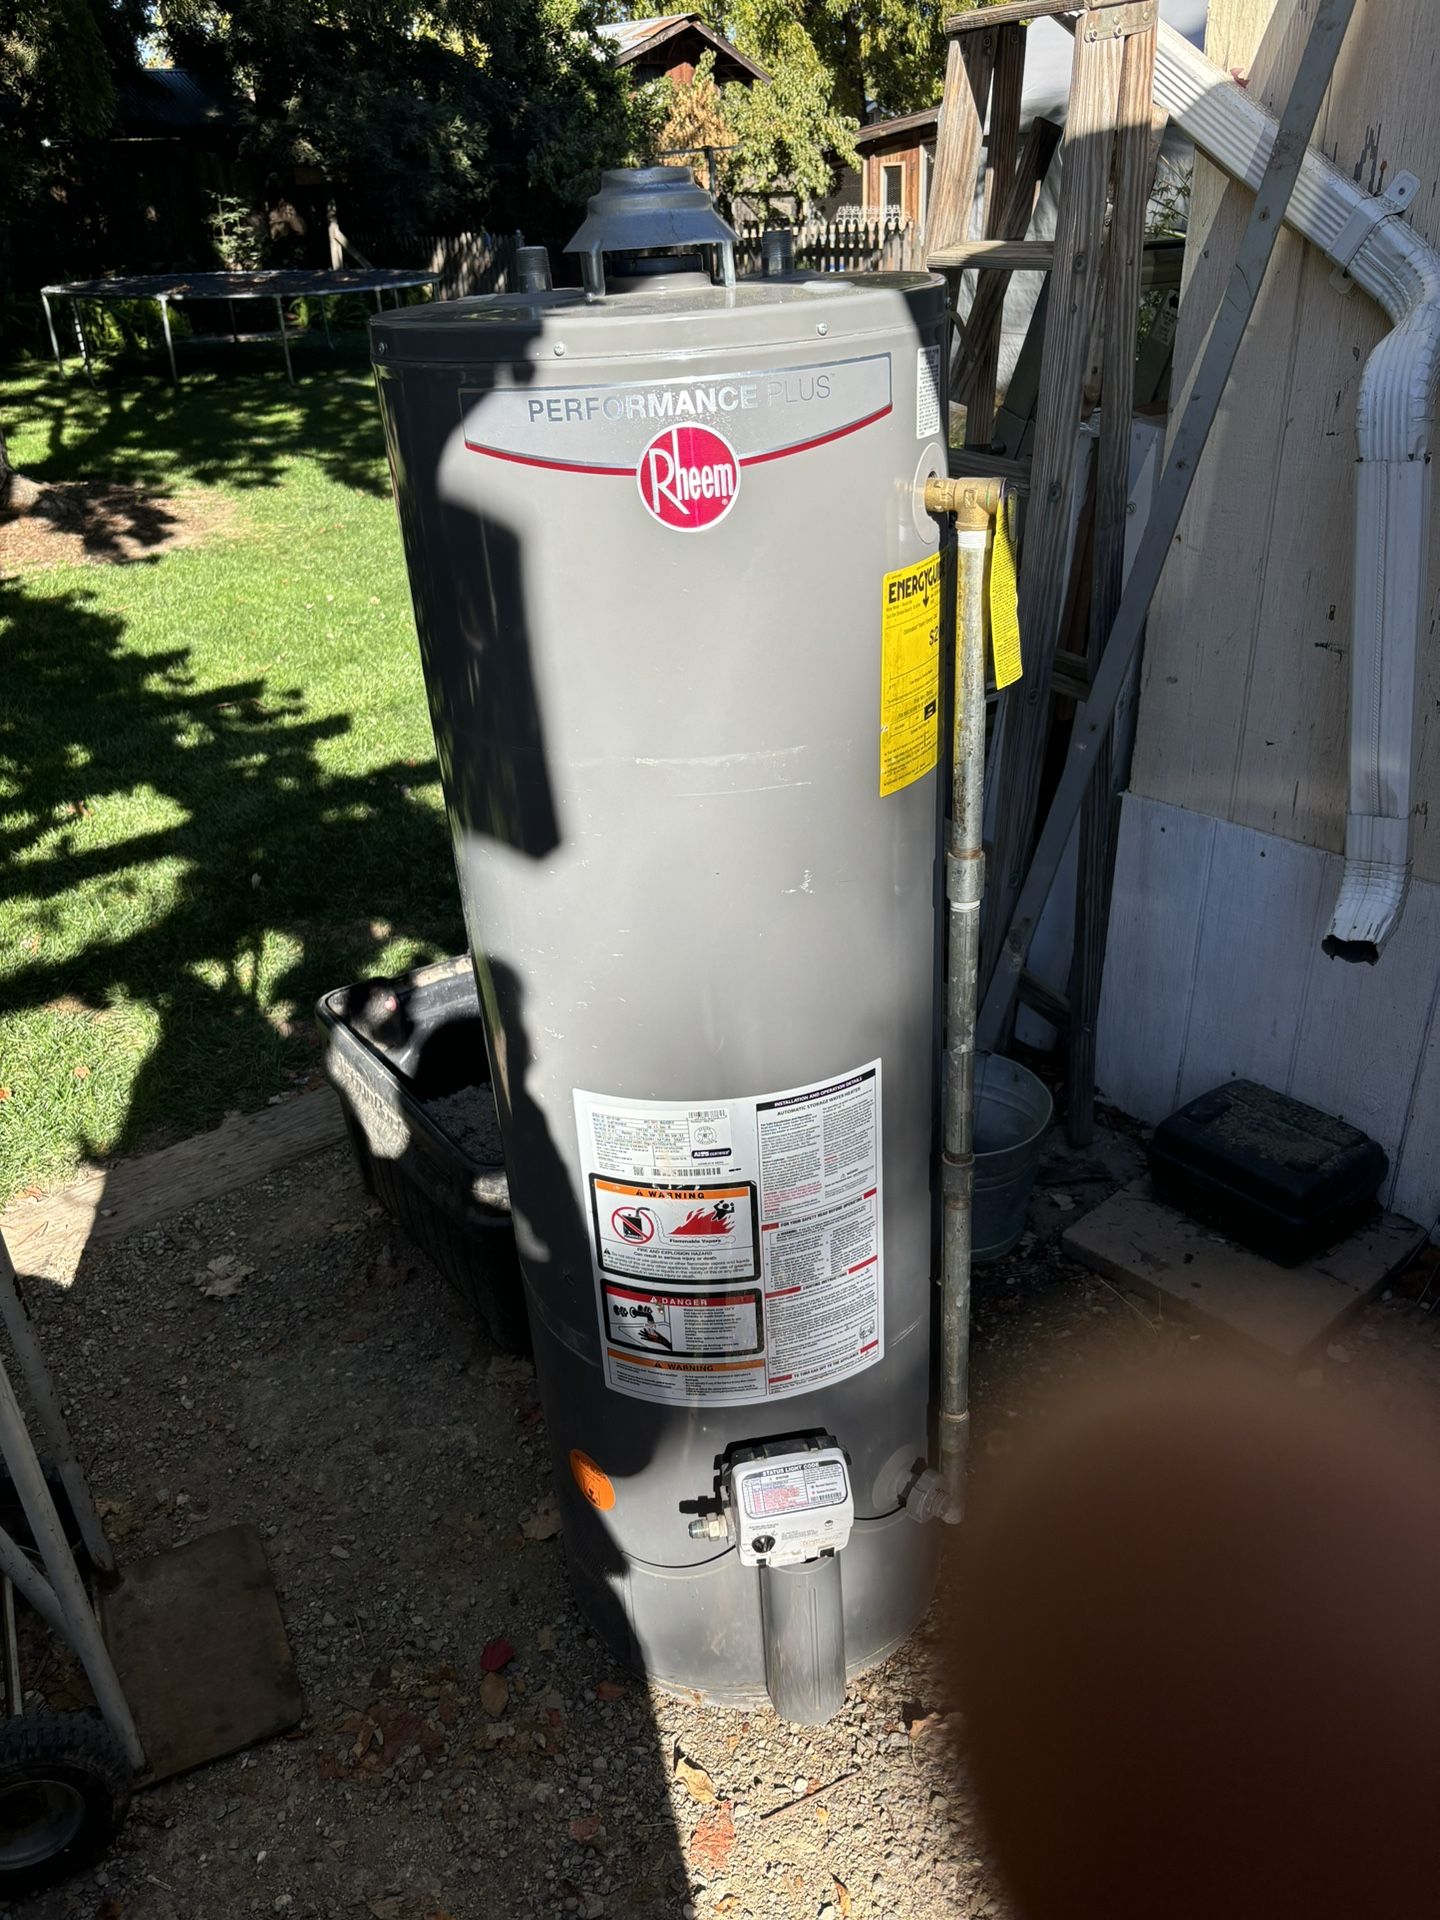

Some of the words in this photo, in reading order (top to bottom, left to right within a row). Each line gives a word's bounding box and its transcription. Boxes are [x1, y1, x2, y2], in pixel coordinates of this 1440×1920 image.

[528, 384, 757, 422] PERFORMANCE
[649, 428, 734, 515] Rheem
[774, 1095, 809, 1107] INSTALLATION
[820, 1084, 846, 1096] OPERATION
[846, 1076, 863, 1087] DETAILS
[777, 1106, 806, 1116] AUTOMATIC
[807, 1099, 828, 1109] STORAGE
[648, 1190, 704, 1199] WARNING
[662, 1297, 708, 1306] DANGER
[668, 1363, 714, 1372] WARNING
[762, 1468, 784, 1476] STATUS
